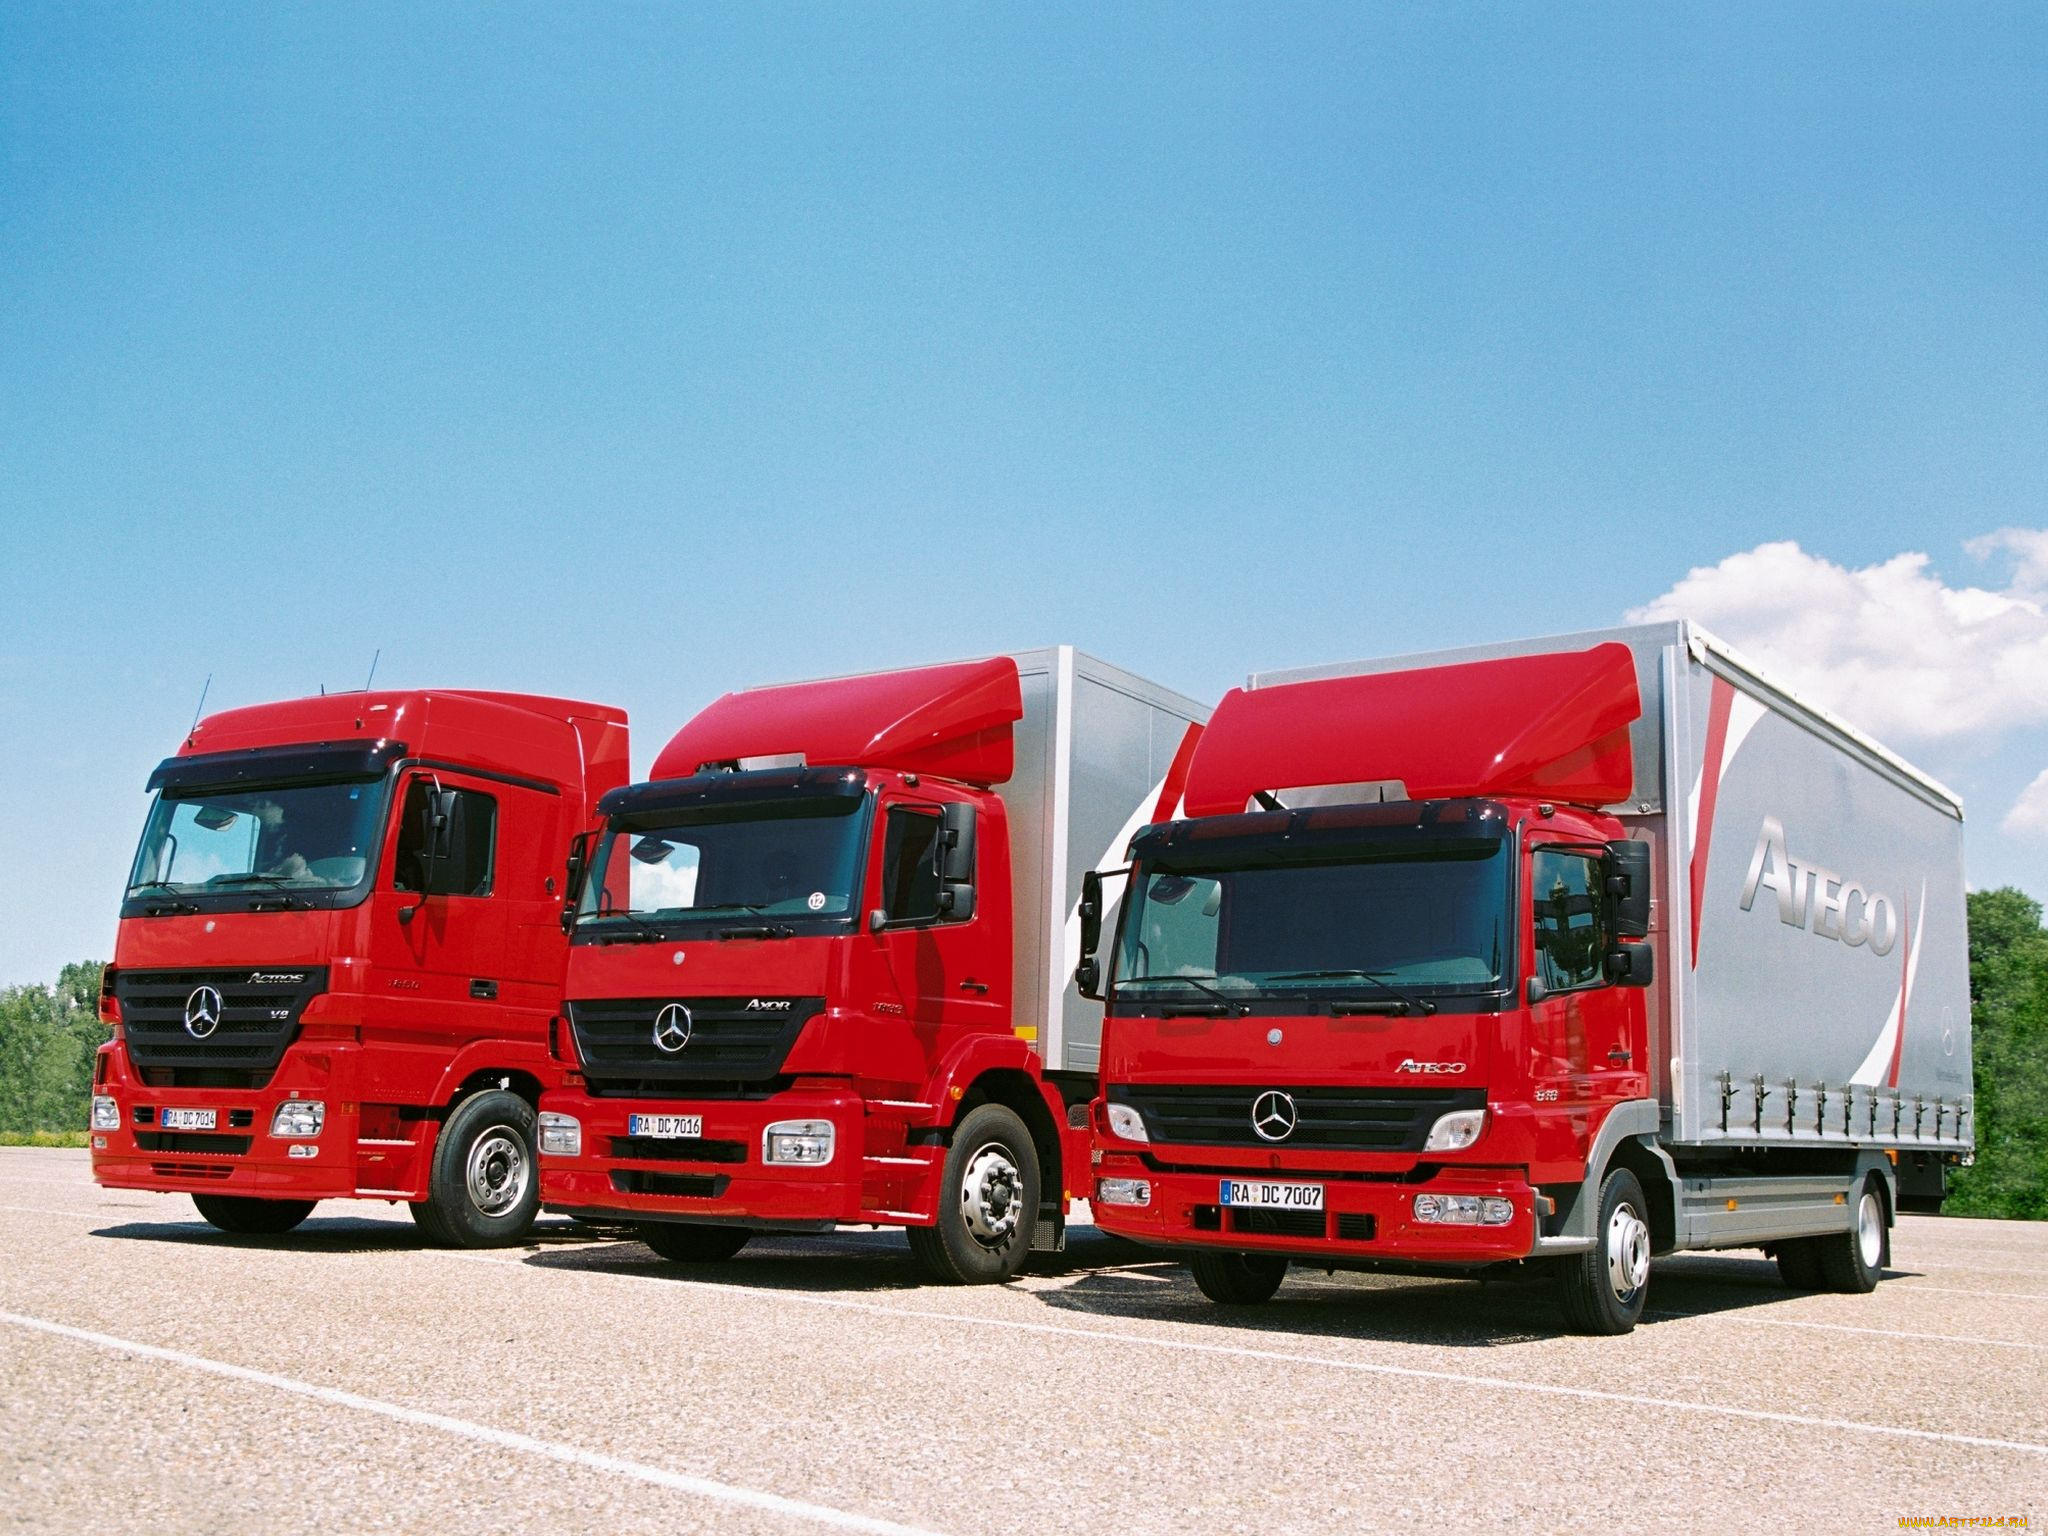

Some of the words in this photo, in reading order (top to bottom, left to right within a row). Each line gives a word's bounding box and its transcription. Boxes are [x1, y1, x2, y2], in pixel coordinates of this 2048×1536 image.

[195, 1112, 214, 1126] 7014
[637, 1117, 650, 1132] RA
[658, 1118, 671, 1133] DC
[674, 1118, 700, 1134] 7016
[1231, 1184, 1249, 1202] RA
[1261, 1185, 1279, 1203] DC
[1284, 1186, 1321, 1206] 7007
